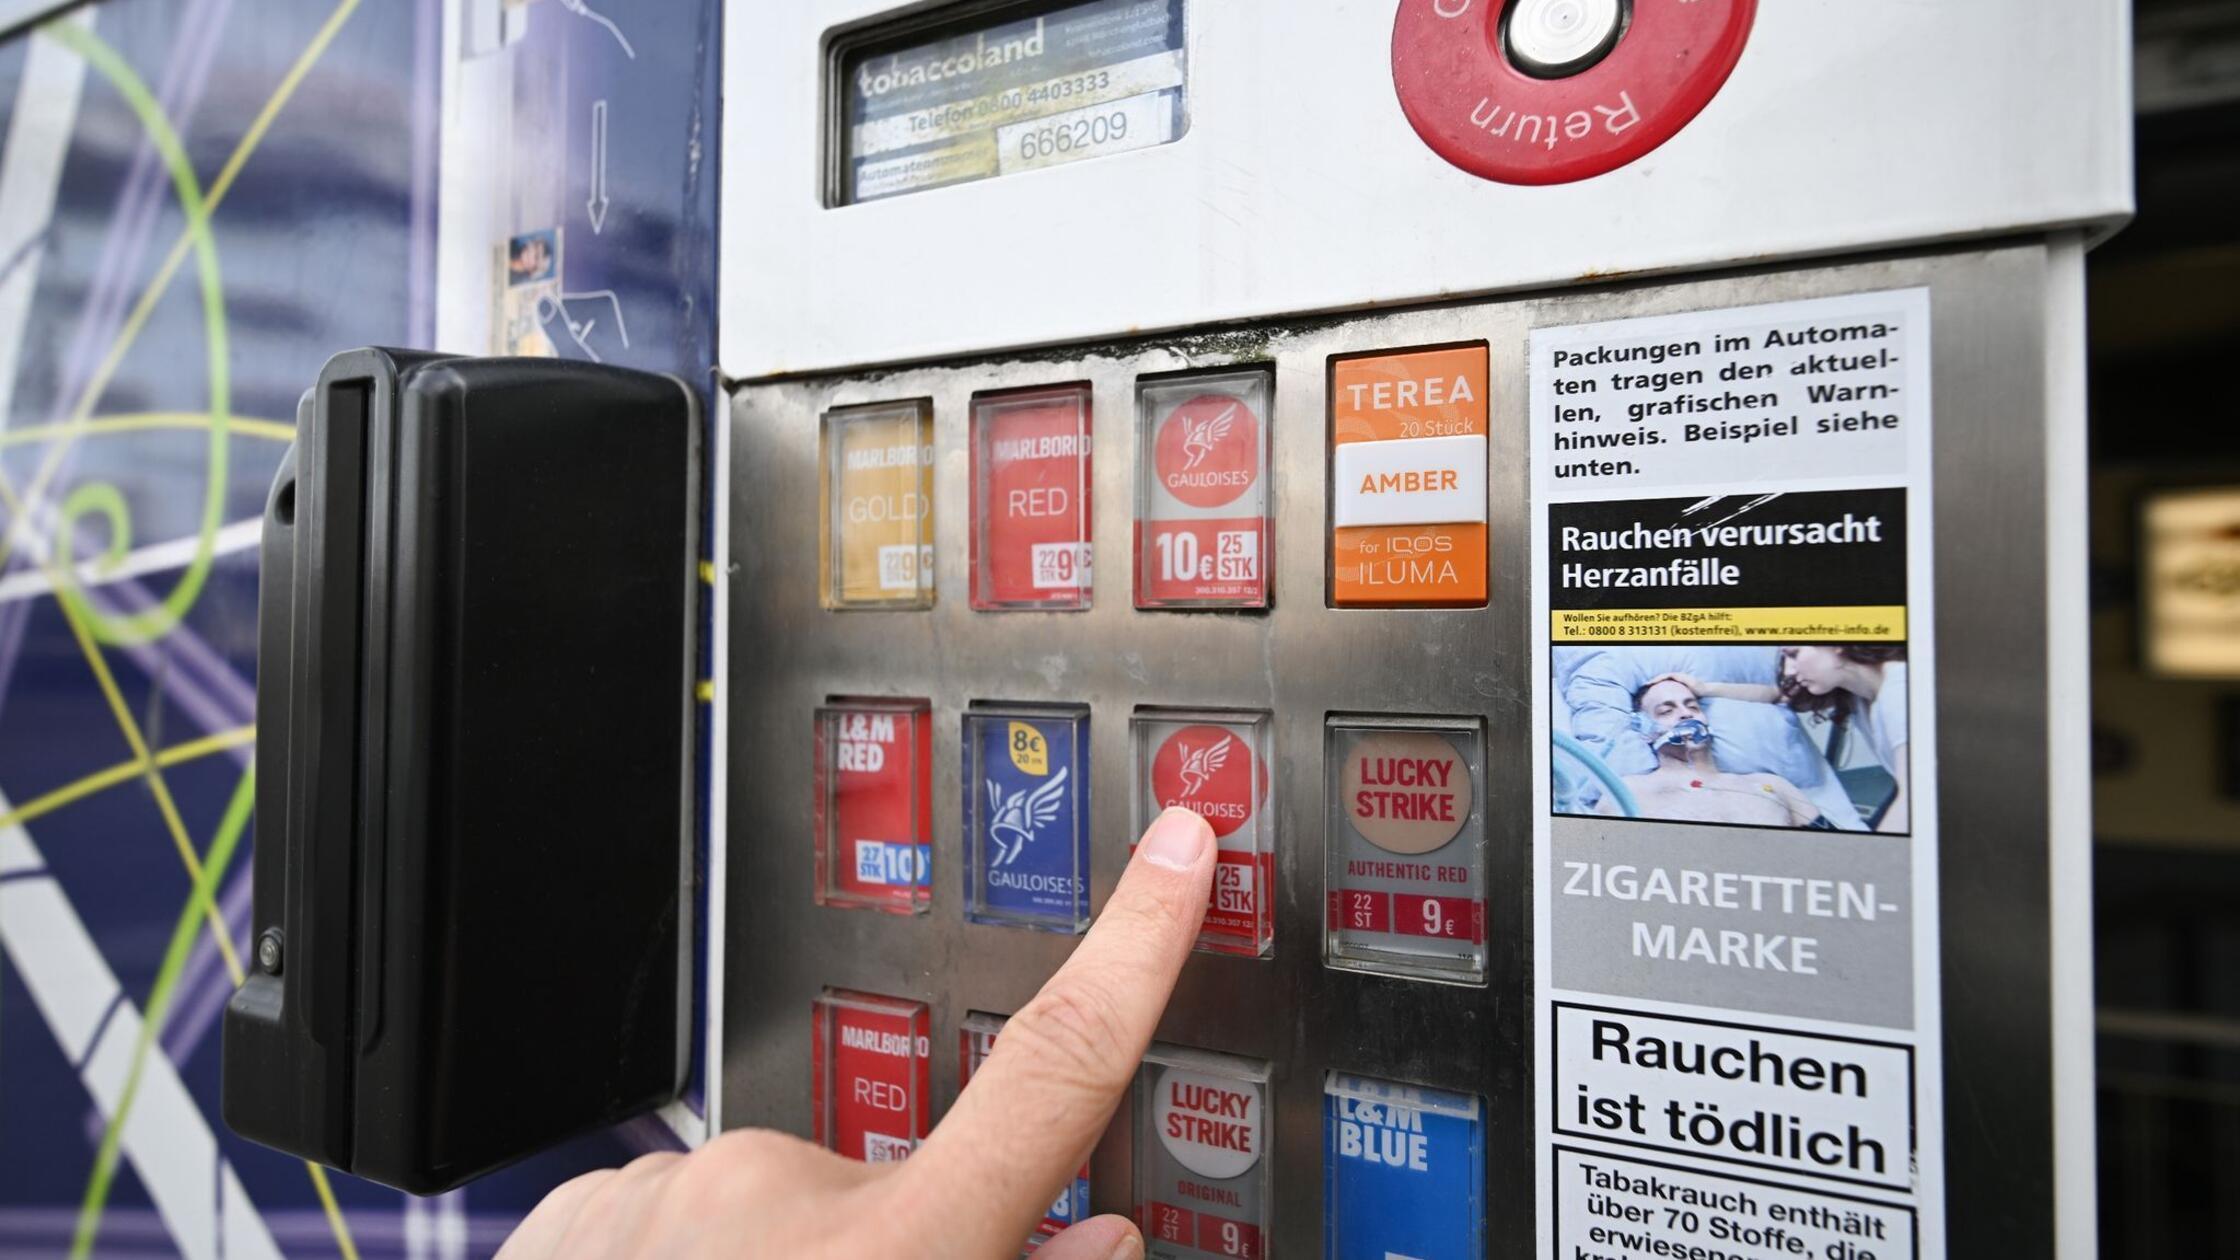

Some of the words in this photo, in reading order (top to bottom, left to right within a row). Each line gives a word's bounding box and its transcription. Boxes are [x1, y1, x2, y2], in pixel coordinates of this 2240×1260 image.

[858, 16, 1045, 98] tobaccoland
[909, 104, 976, 132] Telefon
[979, 91, 1023, 118] 0800
[1028, 71, 1110, 106] 4403333
[1470, 91, 1641, 150] Return
[1020, 112, 1128, 160] 666209
[1554, 339, 1700, 368] Packungen
[1714, 334, 1750, 354] im
[1763, 322, 1899, 349] Automa-
[1554, 375, 1596, 396] ten
[1611, 369, 1702, 392] tragen
[1719, 361, 1773, 382] den
[1790, 348, 1899, 377] aktuel-
[1347, 375, 1474, 411] TEREA
[1554, 404, 1601, 424] len,
[1627, 388, 1778, 422] grafischen
[1807, 382, 1899, 404] Warn-
[1400, 421, 1420, 438] 20
[1425, 417, 1474, 437] Stück
[1554, 426, 1667, 451] hinweis.
[1684, 416, 1798, 444] Beispiel
[1817, 410, 1899, 434] siehe
[1168, 470, 1249, 488] GAULOISES
[1360, 469, 1458, 494] AMBER
[1554, 457, 1640, 479] unten.
[850, 493, 929, 523] GOLD
[1009, 488, 1068, 517] RED
[1221, 534, 1242, 554] 25
[1360, 540, 1380, 554] for
[1387, 536, 1453, 555] IQOS
[1562, 522, 1692, 552] Rauchen
[1702, 513, 1882, 547] verursacht
[1039, 551, 1056, 569] 22
[1156, 531, 1213, 581] 10€
[1221, 557, 1252, 578] STK
[1359, 560, 1459, 585] ILUMA
[1562, 557, 1739, 589] Herzanfälle
[1563, 613, 1595, 623] Wollen
[1597, 612, 1610, 622] Sie
[1612, 612, 1660, 623] aufhören?
[1662, 612, 1678, 622] Die
[1588, 626, 1616, 636] 0800
[1618, 626, 1626, 636] 8
[1628, 625, 1667, 636] 313131
[1745, 624, 1891, 636] www.rauchfrei-info.de
[839, 713, 895, 743] L&M
[1014, 729, 1040, 753] 8€
[838, 743, 884, 772] RED
[1017, 754, 1030, 765] 20
[1361, 757, 1453, 787] LUCKY
[1356, 791, 1455, 822] STRIKE
[862, 846, 880, 862] 27
[860, 863, 881, 878] STK
[1220, 866, 1240, 887] 25
[1348, 860, 1431, 881] AUTHENTIC
[1437, 866, 1467, 883] RED
[1221, 889, 1252, 911] STK
[1354, 894, 1372, 910] 22
[1563, 862, 1898, 921] ZIGARETTEN-
[1355, 912, 1372, 928] ST
[1632, 922, 1818, 975] MARKE
[1592, 1019, 1868, 1098] Rauchen
[854, 1077, 907, 1112] RED
[1171, 1082, 1252, 1119] LUCKY
[1339, 1096, 1423, 1133] L&M
[1577, 1084, 1646, 1135] ist
[1664, 1100, 1886, 1175] tödlich
[1168, 1112, 1252, 1153] STRIKE
[1340, 1121, 1428, 1172] BLUE
[1178, 1180, 1242, 1208] ORIGINAL
[1579, 1163, 1758, 1217] Tabakrauch
[1769, 1201, 1887, 1241] enthält
[1162, 1207, 1179, 1224] 22
[1587, 1193, 1654, 1225] über
[1663, 1208, 1699, 1234] 70
[1709, 1217, 1814, 1258] Stoffe,
[1826, 1240, 1877, 1260] die
[1163, 1225, 1180, 1241] ST
[1589, 1226, 1750, 1260] erwiesen
